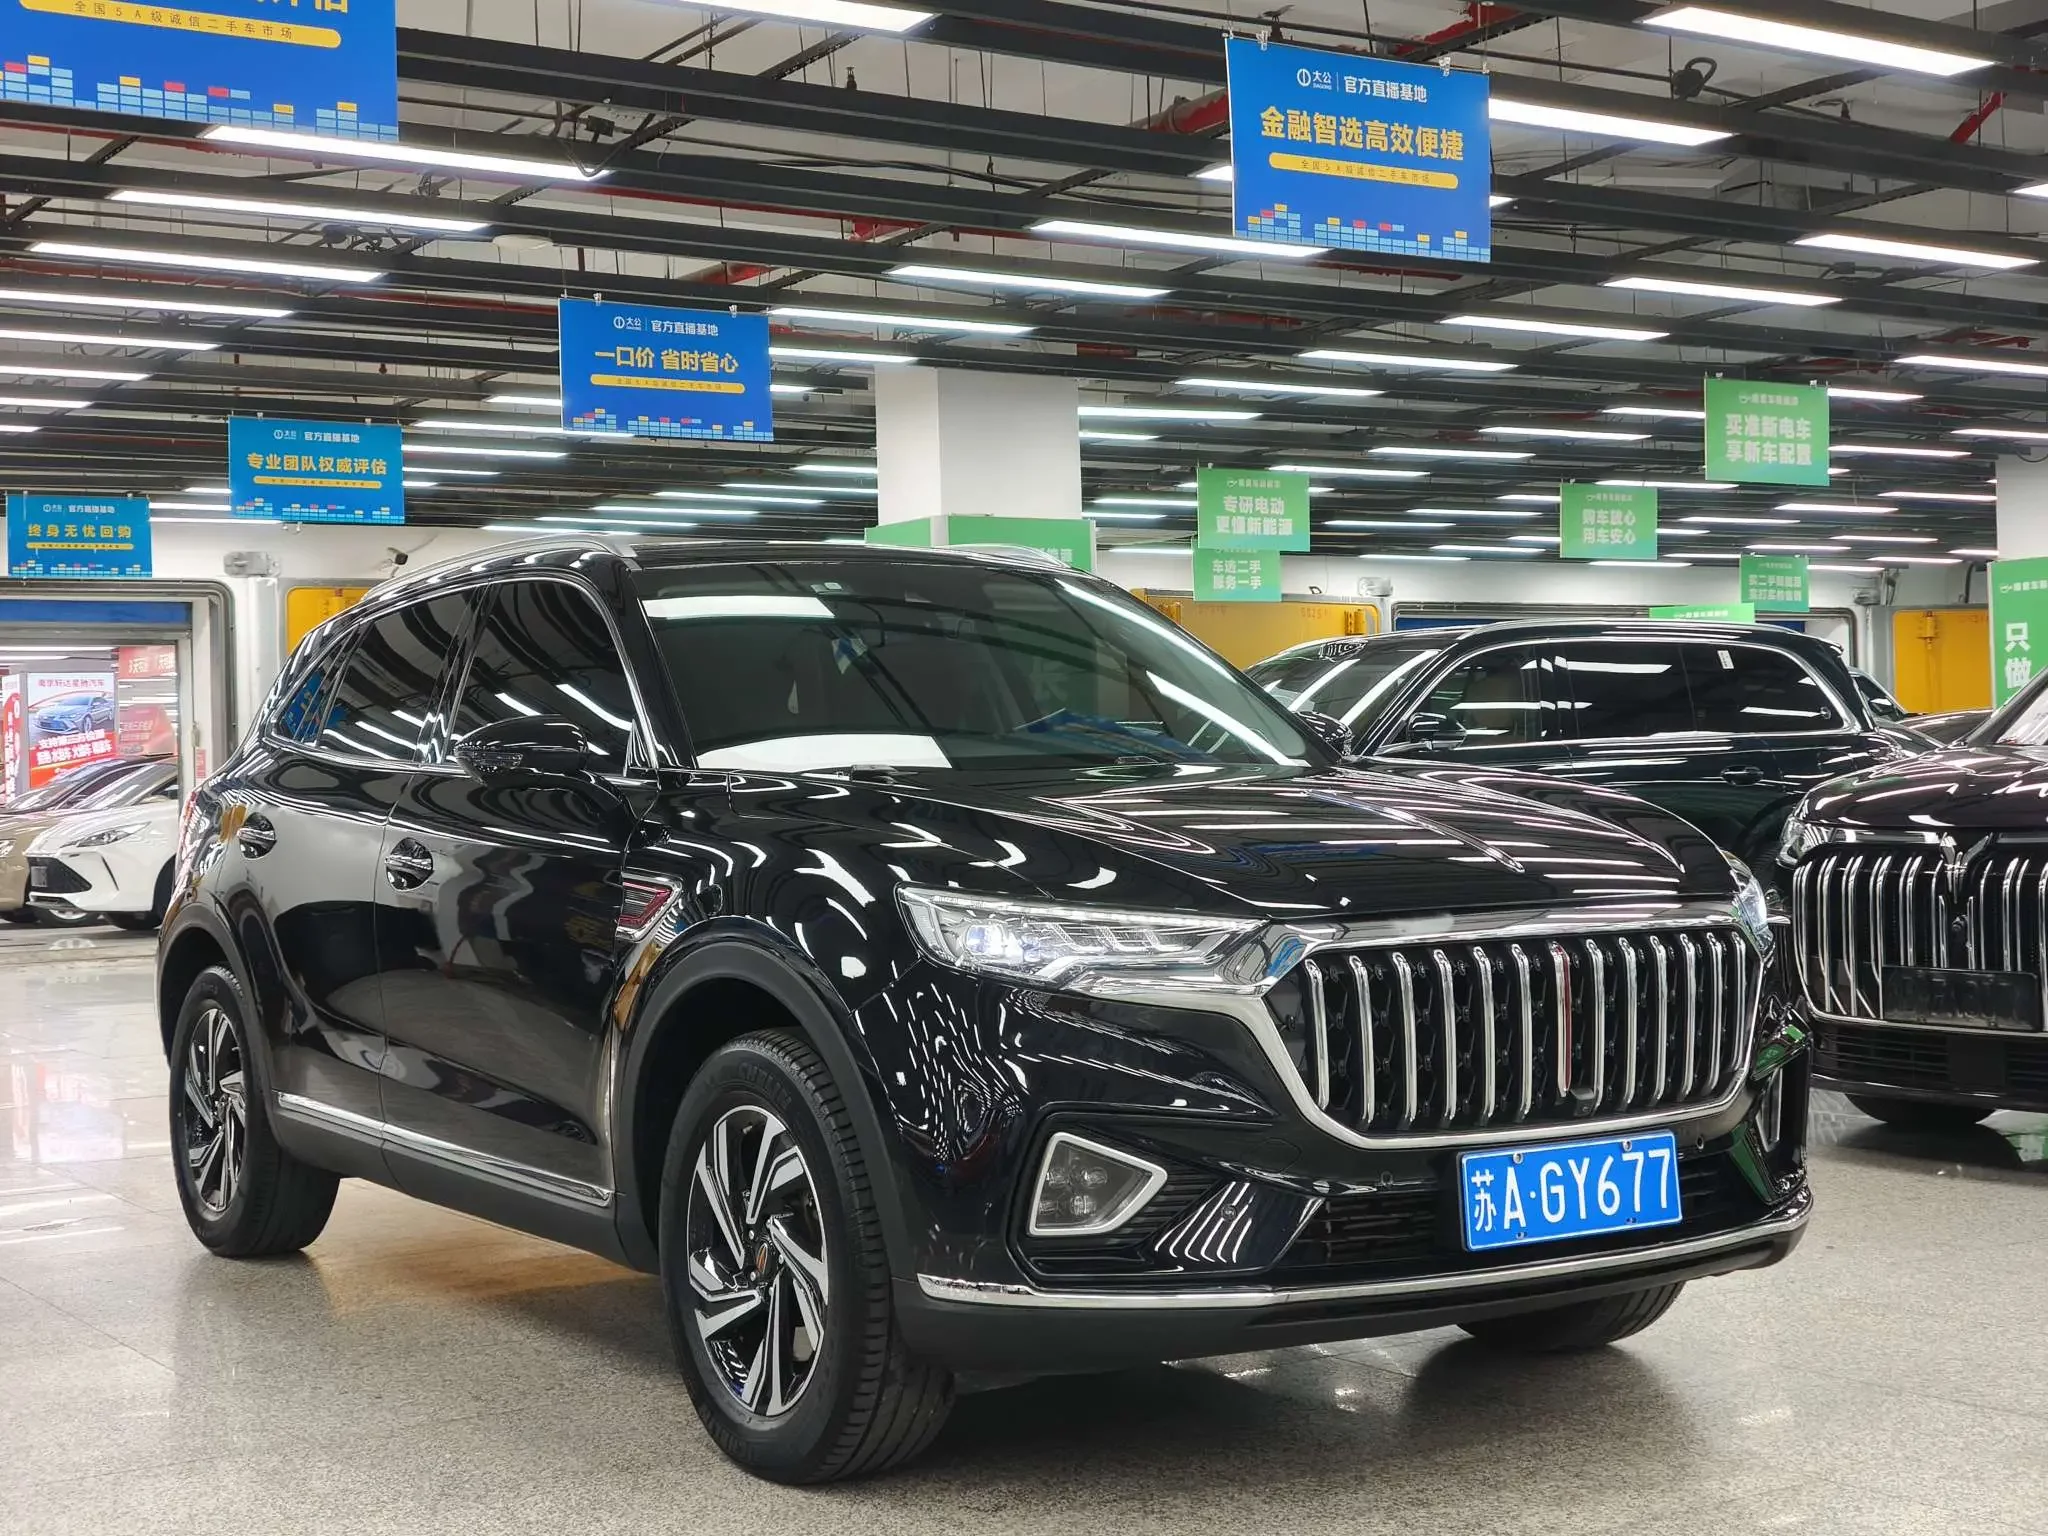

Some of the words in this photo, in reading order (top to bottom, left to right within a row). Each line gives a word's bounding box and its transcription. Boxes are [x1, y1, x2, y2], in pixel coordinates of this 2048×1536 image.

[73, 1, 293, 39] 全国5A级诚信二手车市场
[1312, 70, 1332, 83] 大公
[1344, 75, 1428, 103] 官方直播基地
[1260, 105, 1464, 161] 金融智选高效便捷
[651, 319, 719, 336] 官方直播基地
[594, 346, 655, 369] 一口价
[660, 348, 739, 373] 省时省心
[1725, 414, 1812, 440] 买准新电车
[247, 452, 388, 476] 专业团队权威评估
[1725, 440, 1813, 466] 享新车配置
[28, 524, 132, 538] 终身无忧回购
[1471, 1148, 1670, 1232] 苏A·GY677
